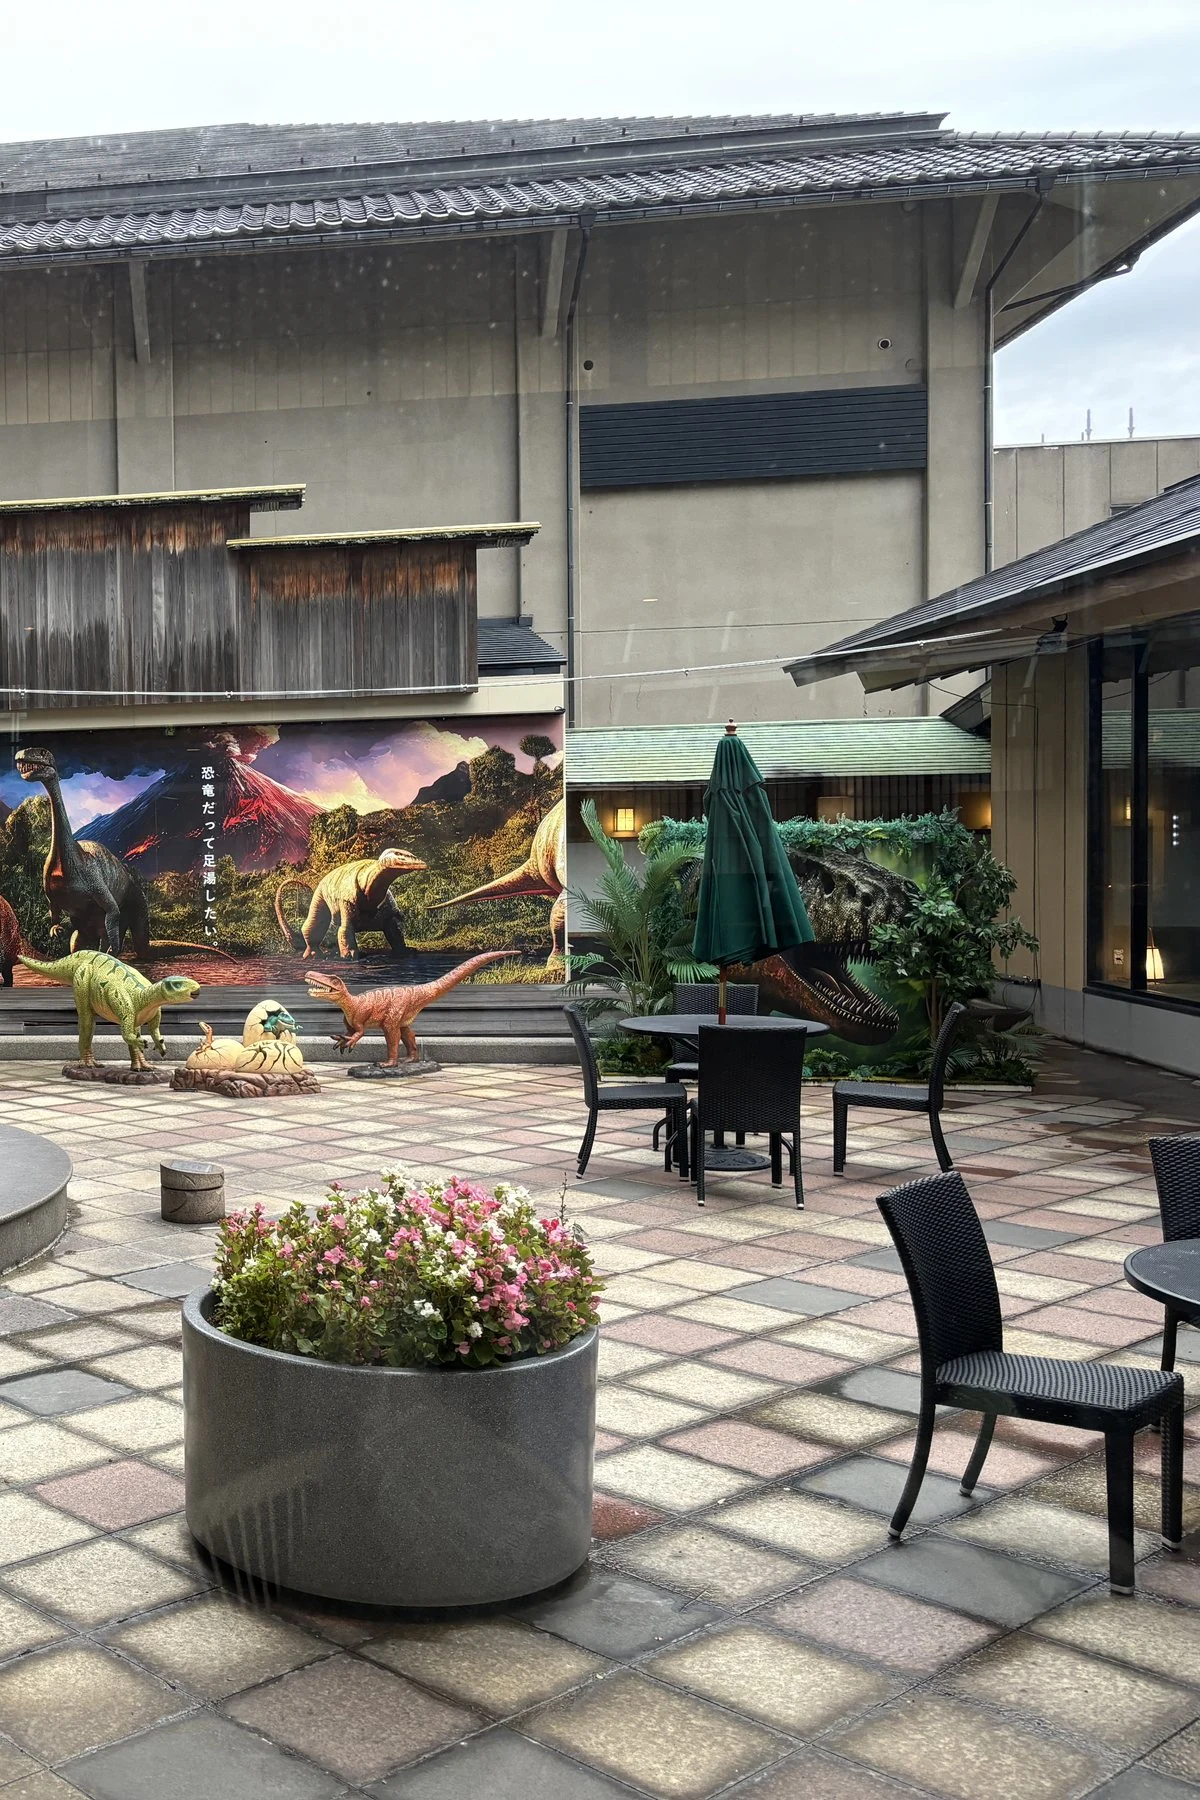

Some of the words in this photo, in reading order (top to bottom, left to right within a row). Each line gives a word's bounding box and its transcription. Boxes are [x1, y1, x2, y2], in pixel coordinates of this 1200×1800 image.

[201, 766, 218, 947] 恐竜だって足湯したい。
